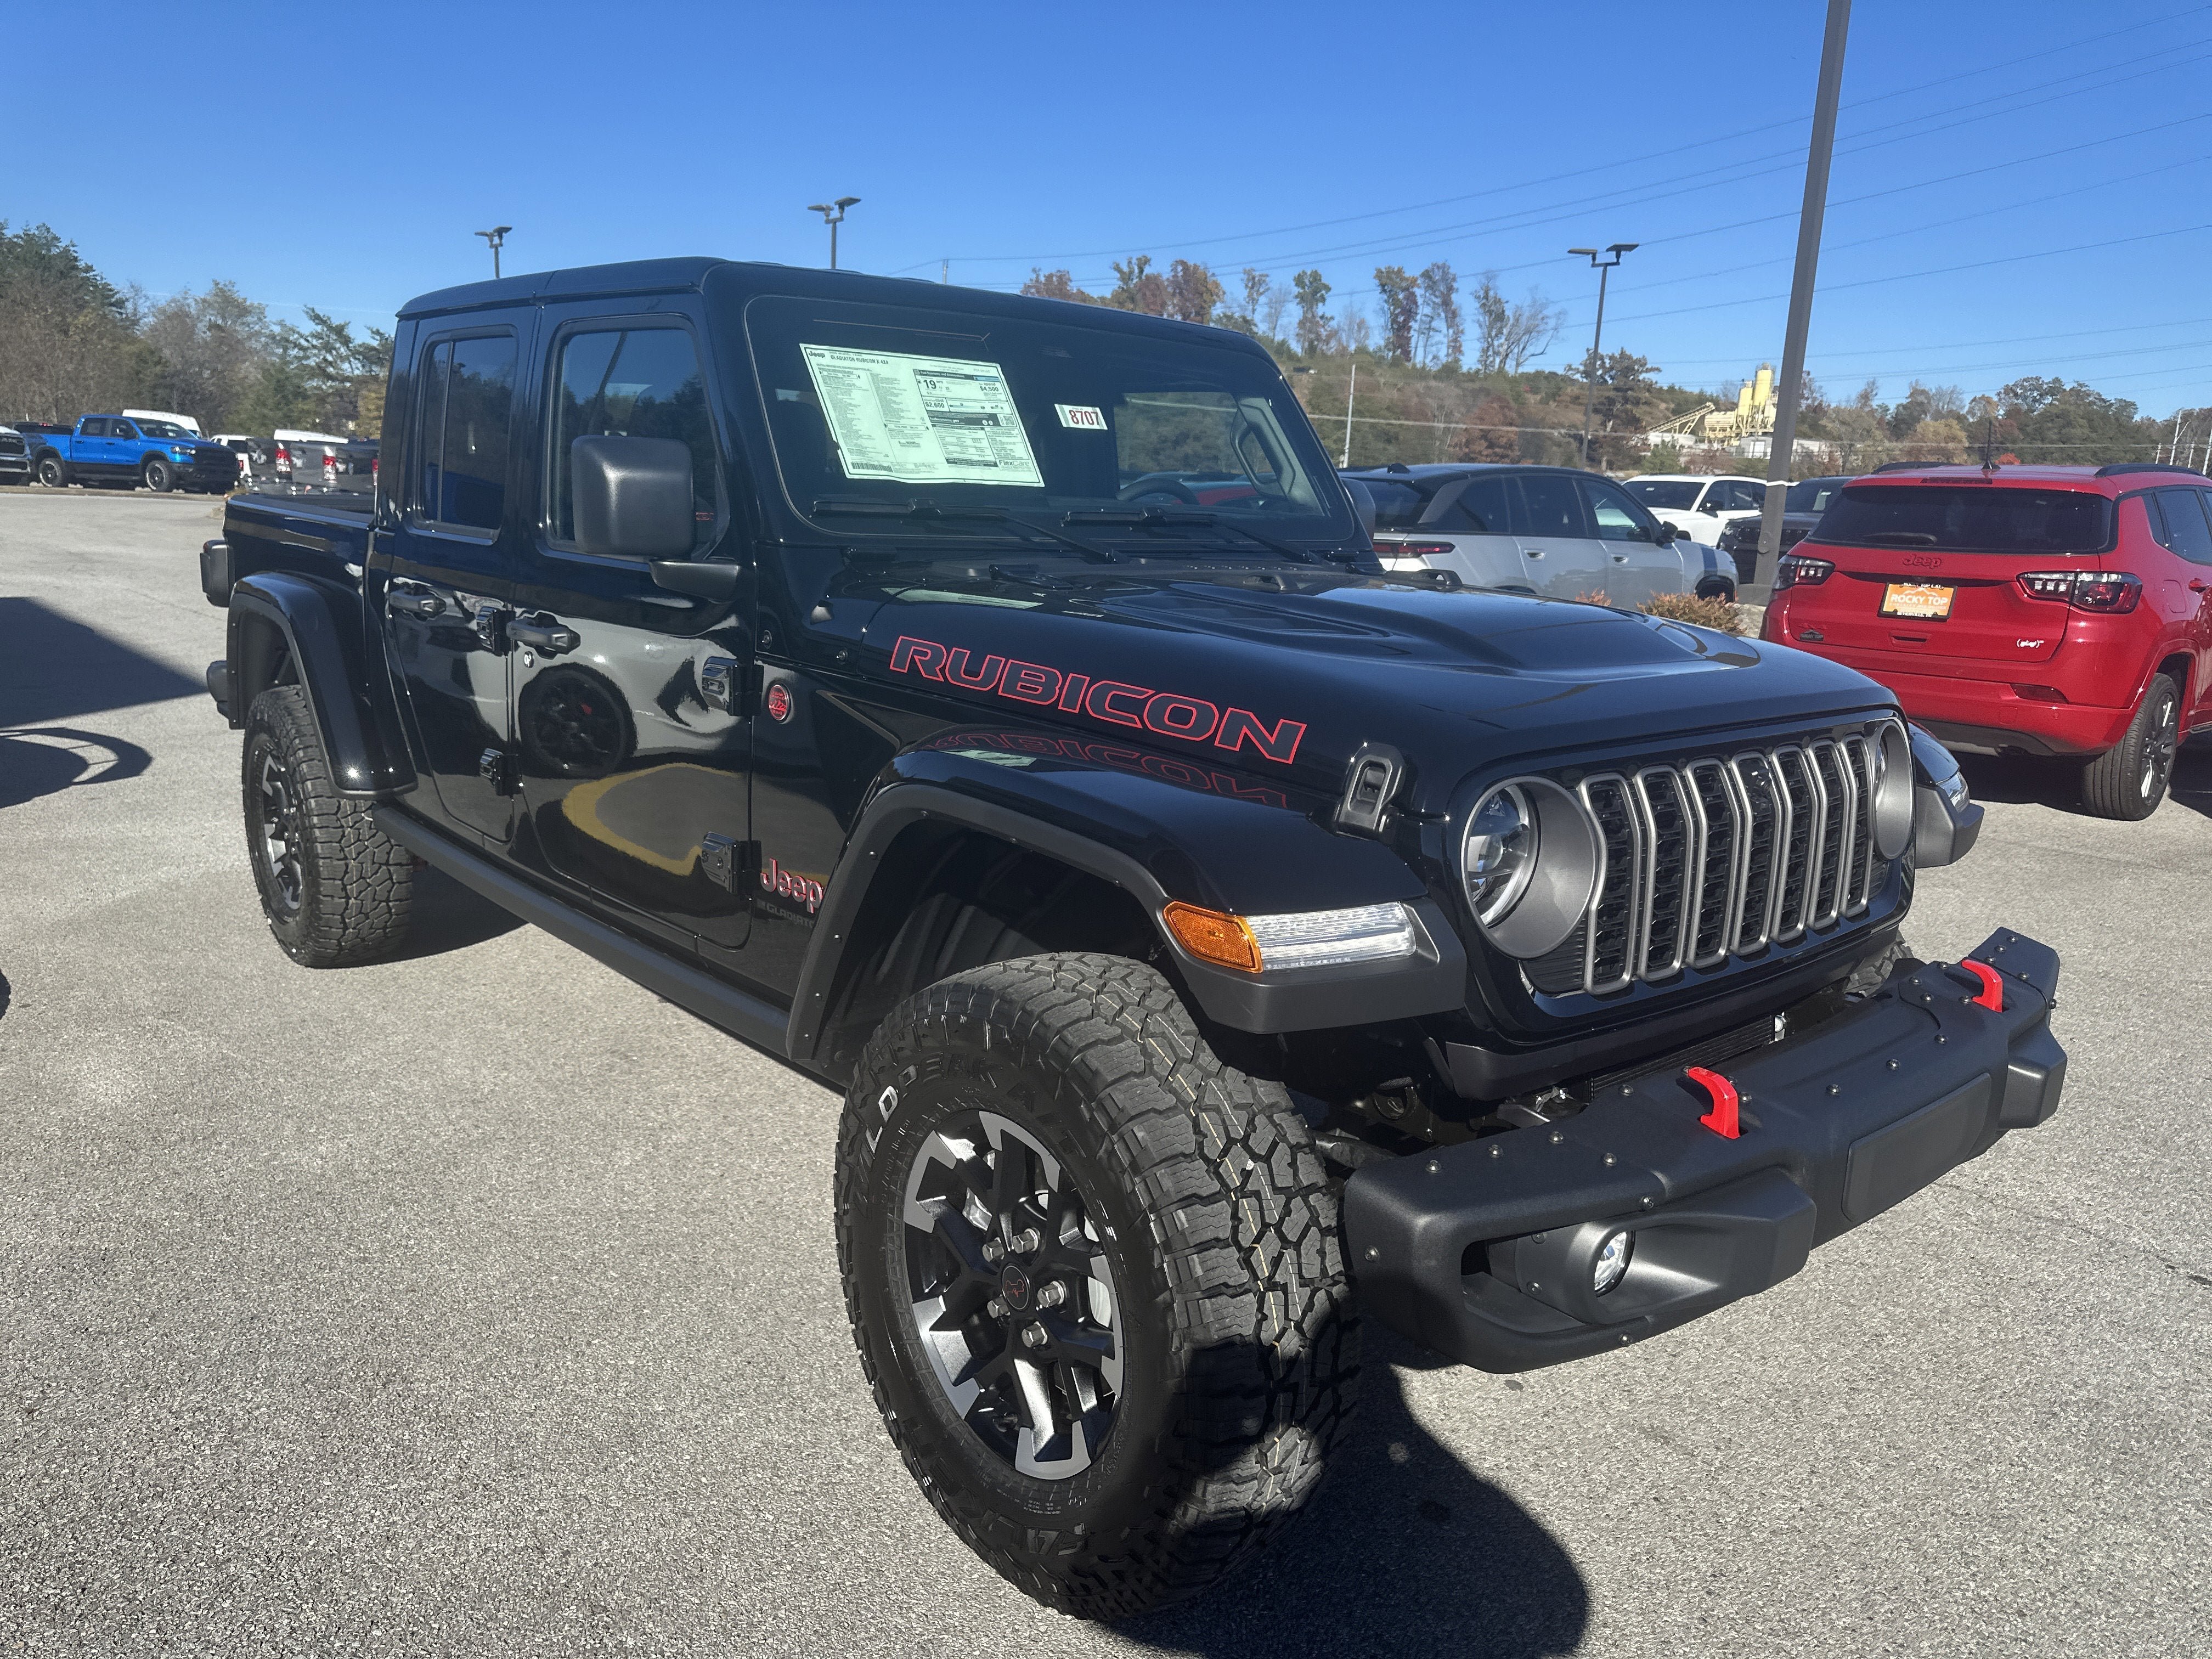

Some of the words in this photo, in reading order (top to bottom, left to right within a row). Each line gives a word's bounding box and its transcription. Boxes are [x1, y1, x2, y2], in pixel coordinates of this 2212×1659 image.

[923, 380, 936, 390] 19
[1069, 409, 1099, 426] 8707
[1901, 554, 1943, 569] Jeep
[1890, 594, 1925, 604] ROCKY
[1927, 596, 1948, 605] TOP
[890, 635, 1307, 764] RUBICON
[760, 857, 824, 914] Jeep
